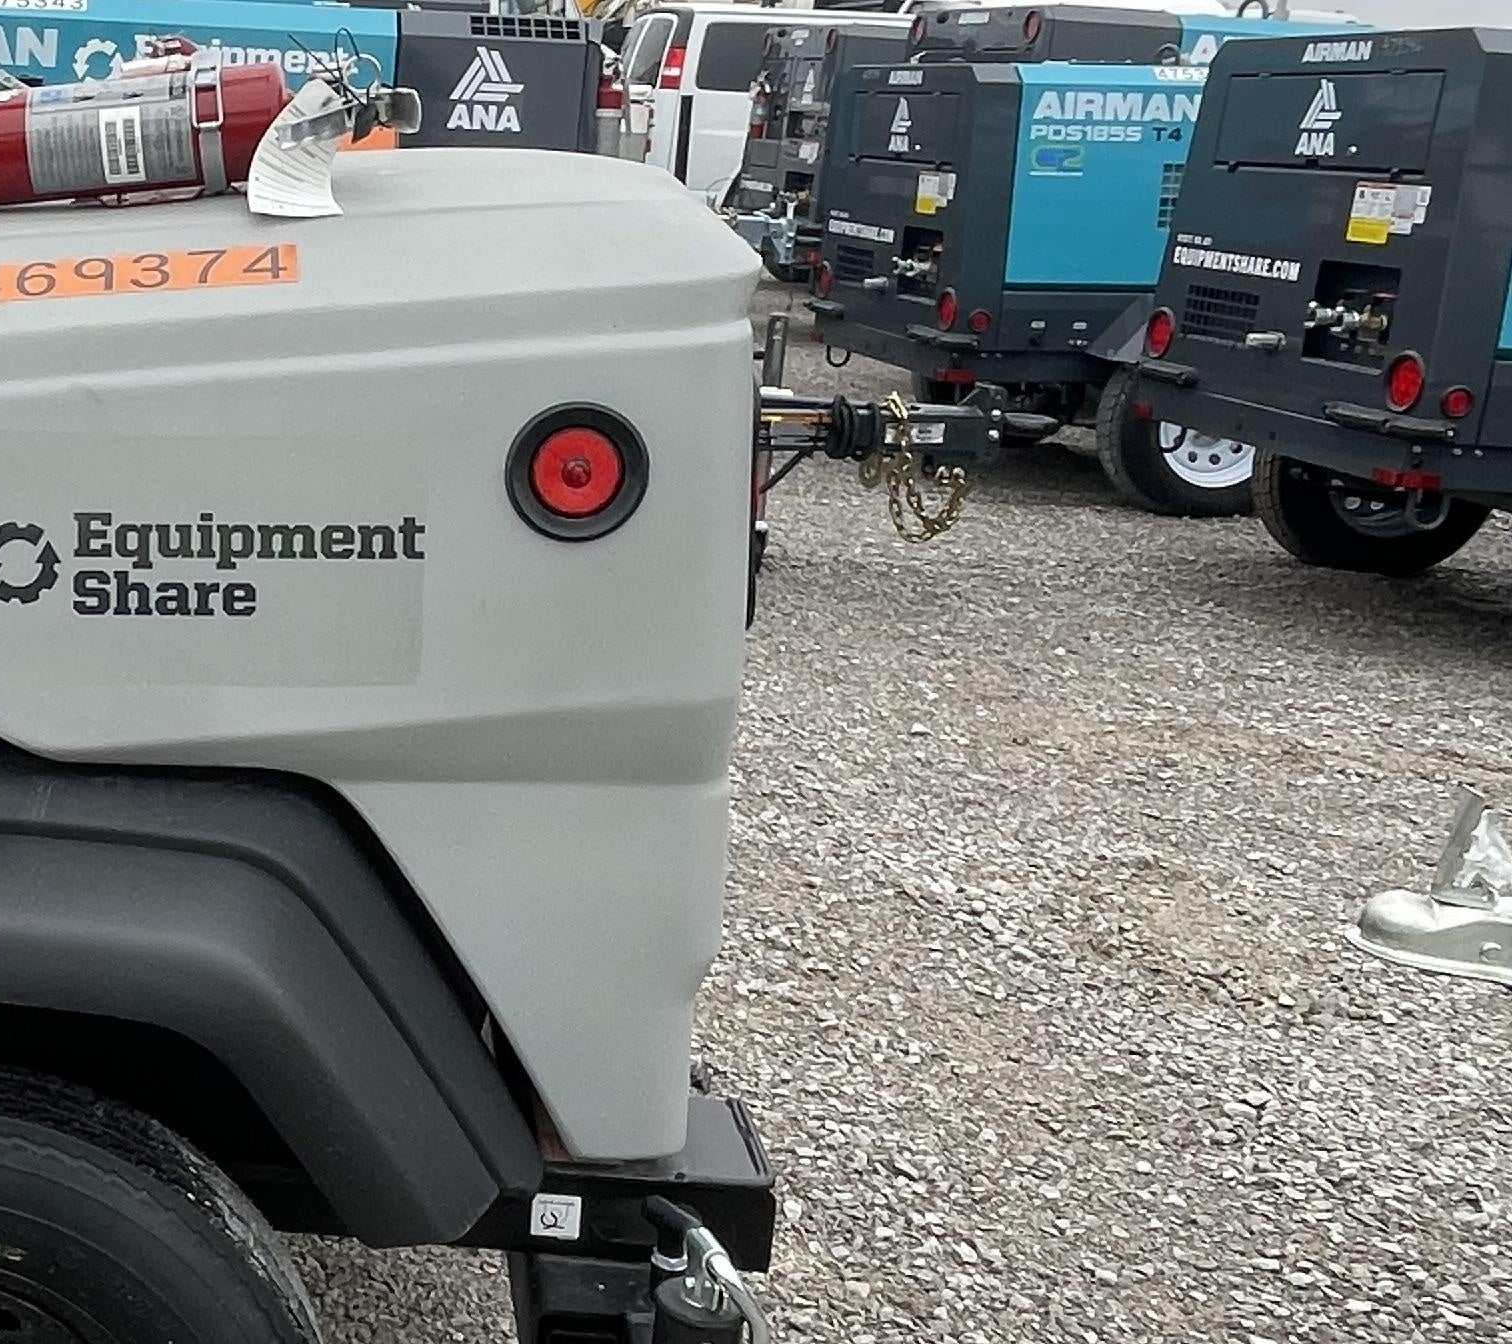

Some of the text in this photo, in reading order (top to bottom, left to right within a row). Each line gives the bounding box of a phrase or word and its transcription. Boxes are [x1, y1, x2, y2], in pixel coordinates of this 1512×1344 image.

[134, 34, 359, 76] Euipment
[1301, 41, 1373, 63] AIRMAN
[1158, 68, 1209, 81] 4753
[447, 104, 522, 132] ANA
[1033, 91, 1202, 122] AIRMAN
[1030, 125, 1182, 142] PDS185S T4
[1295, 132, 1334, 156] ANA
[73, 512, 426, 570] Equipment
[72, 570, 256, 617] Share
